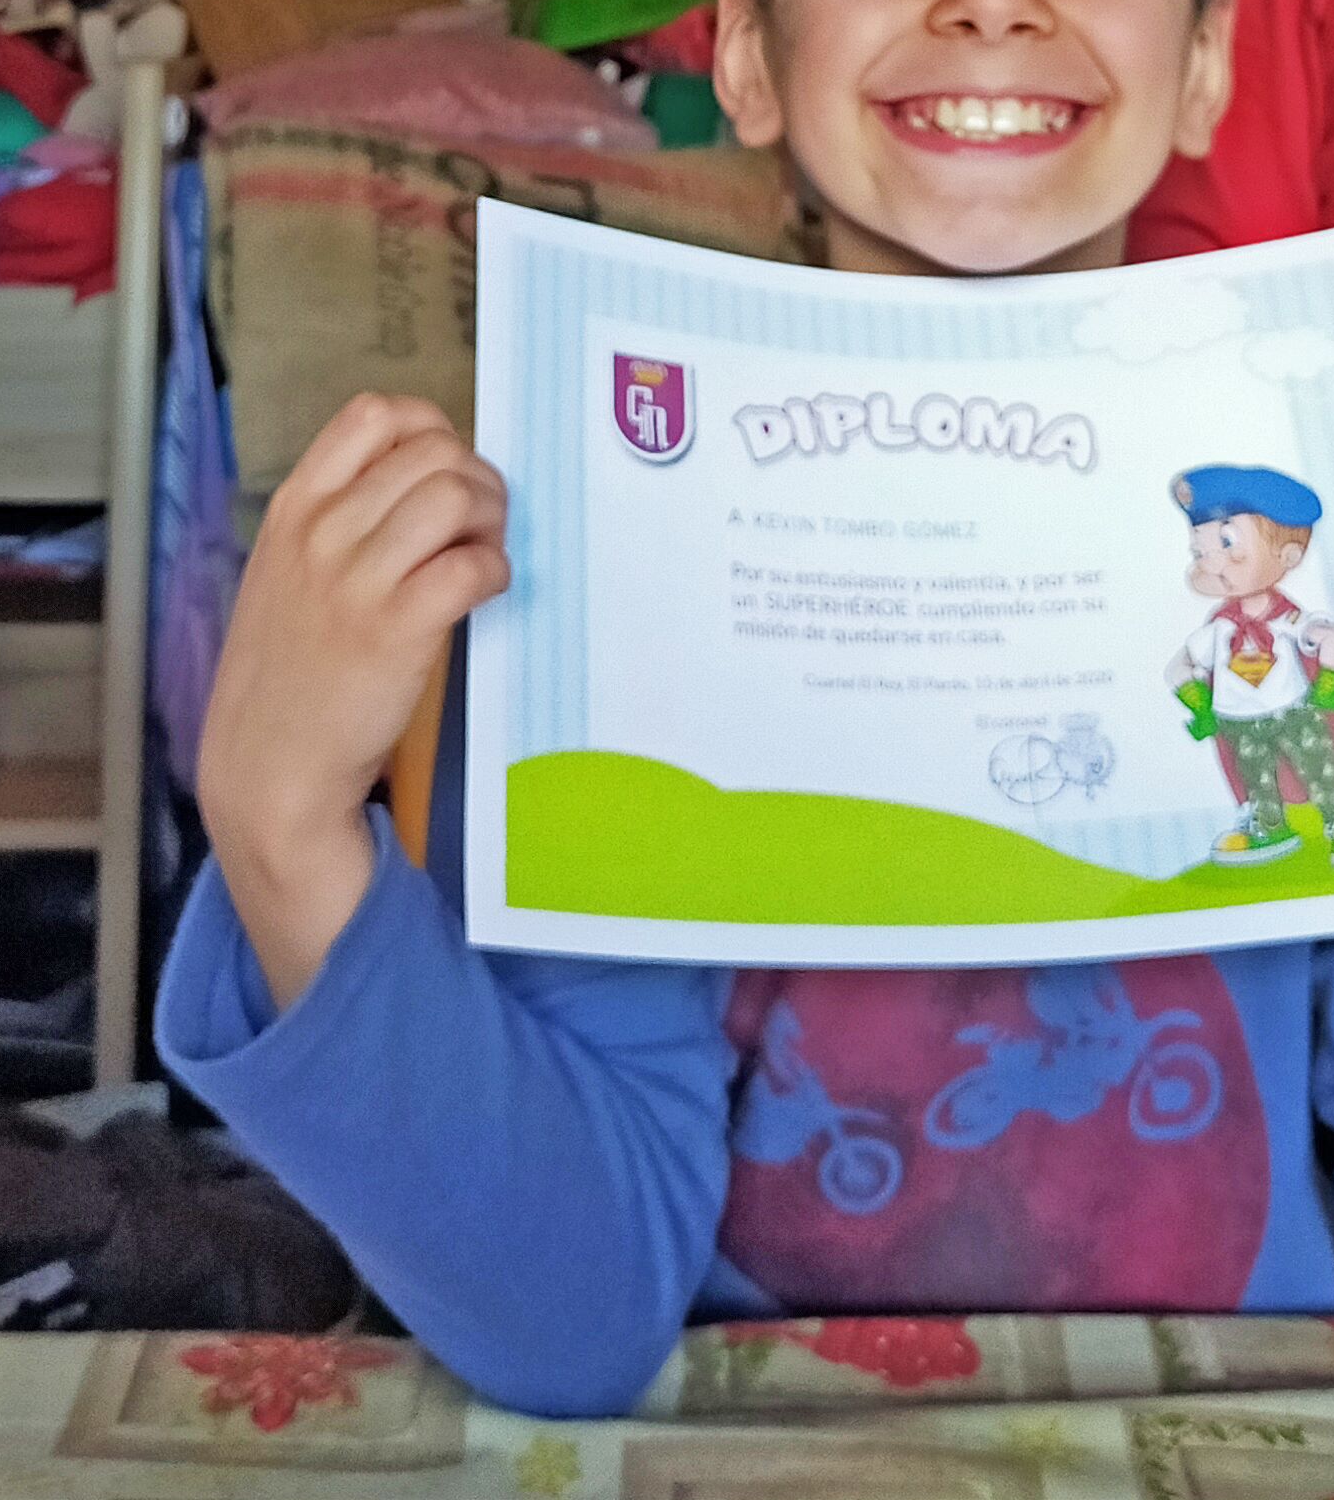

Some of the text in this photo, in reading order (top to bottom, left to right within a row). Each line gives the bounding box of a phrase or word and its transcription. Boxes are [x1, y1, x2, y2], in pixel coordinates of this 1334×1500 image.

[732, 391, 1101, 474] DIPLOMA
[728, 506, 744, 525] A
[731, 559, 765, 582] Por
[1032, 572, 1066, 592] por
[1072, 569, 1104, 585] ser
[917, 599, 1037, 619] cumpliendo
[1040, 599, 1078, 615] con
